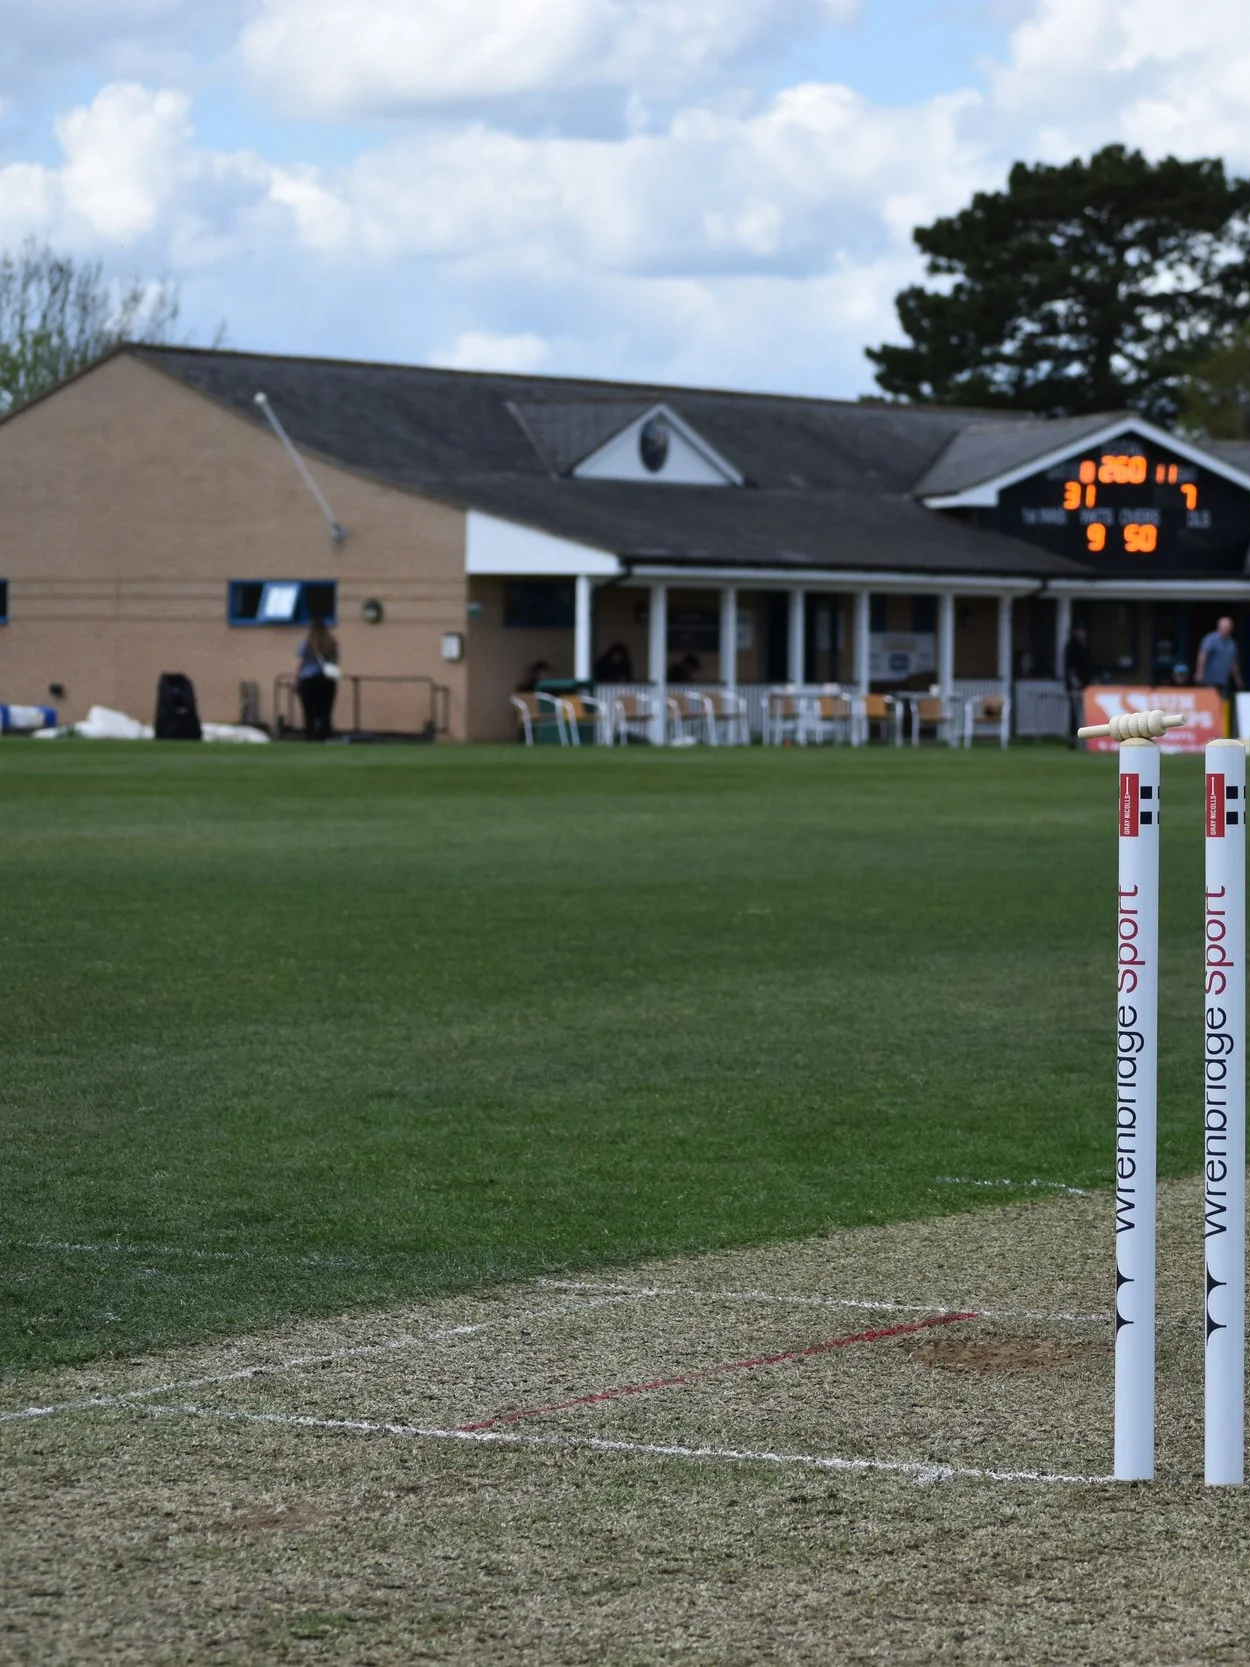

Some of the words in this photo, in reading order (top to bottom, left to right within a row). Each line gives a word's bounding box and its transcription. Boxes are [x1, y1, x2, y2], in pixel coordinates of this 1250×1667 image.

[1156, 464, 1178, 485] 11
[1087, 522, 1106, 552] 9
[1116, 885, 1146, 994] Sport
[1205, 885, 1234, 995] Sport
[1115, 1005, 1145, 1234] Wrenbridge
[1204, 1006, 1234, 1239] Wrenbridge
